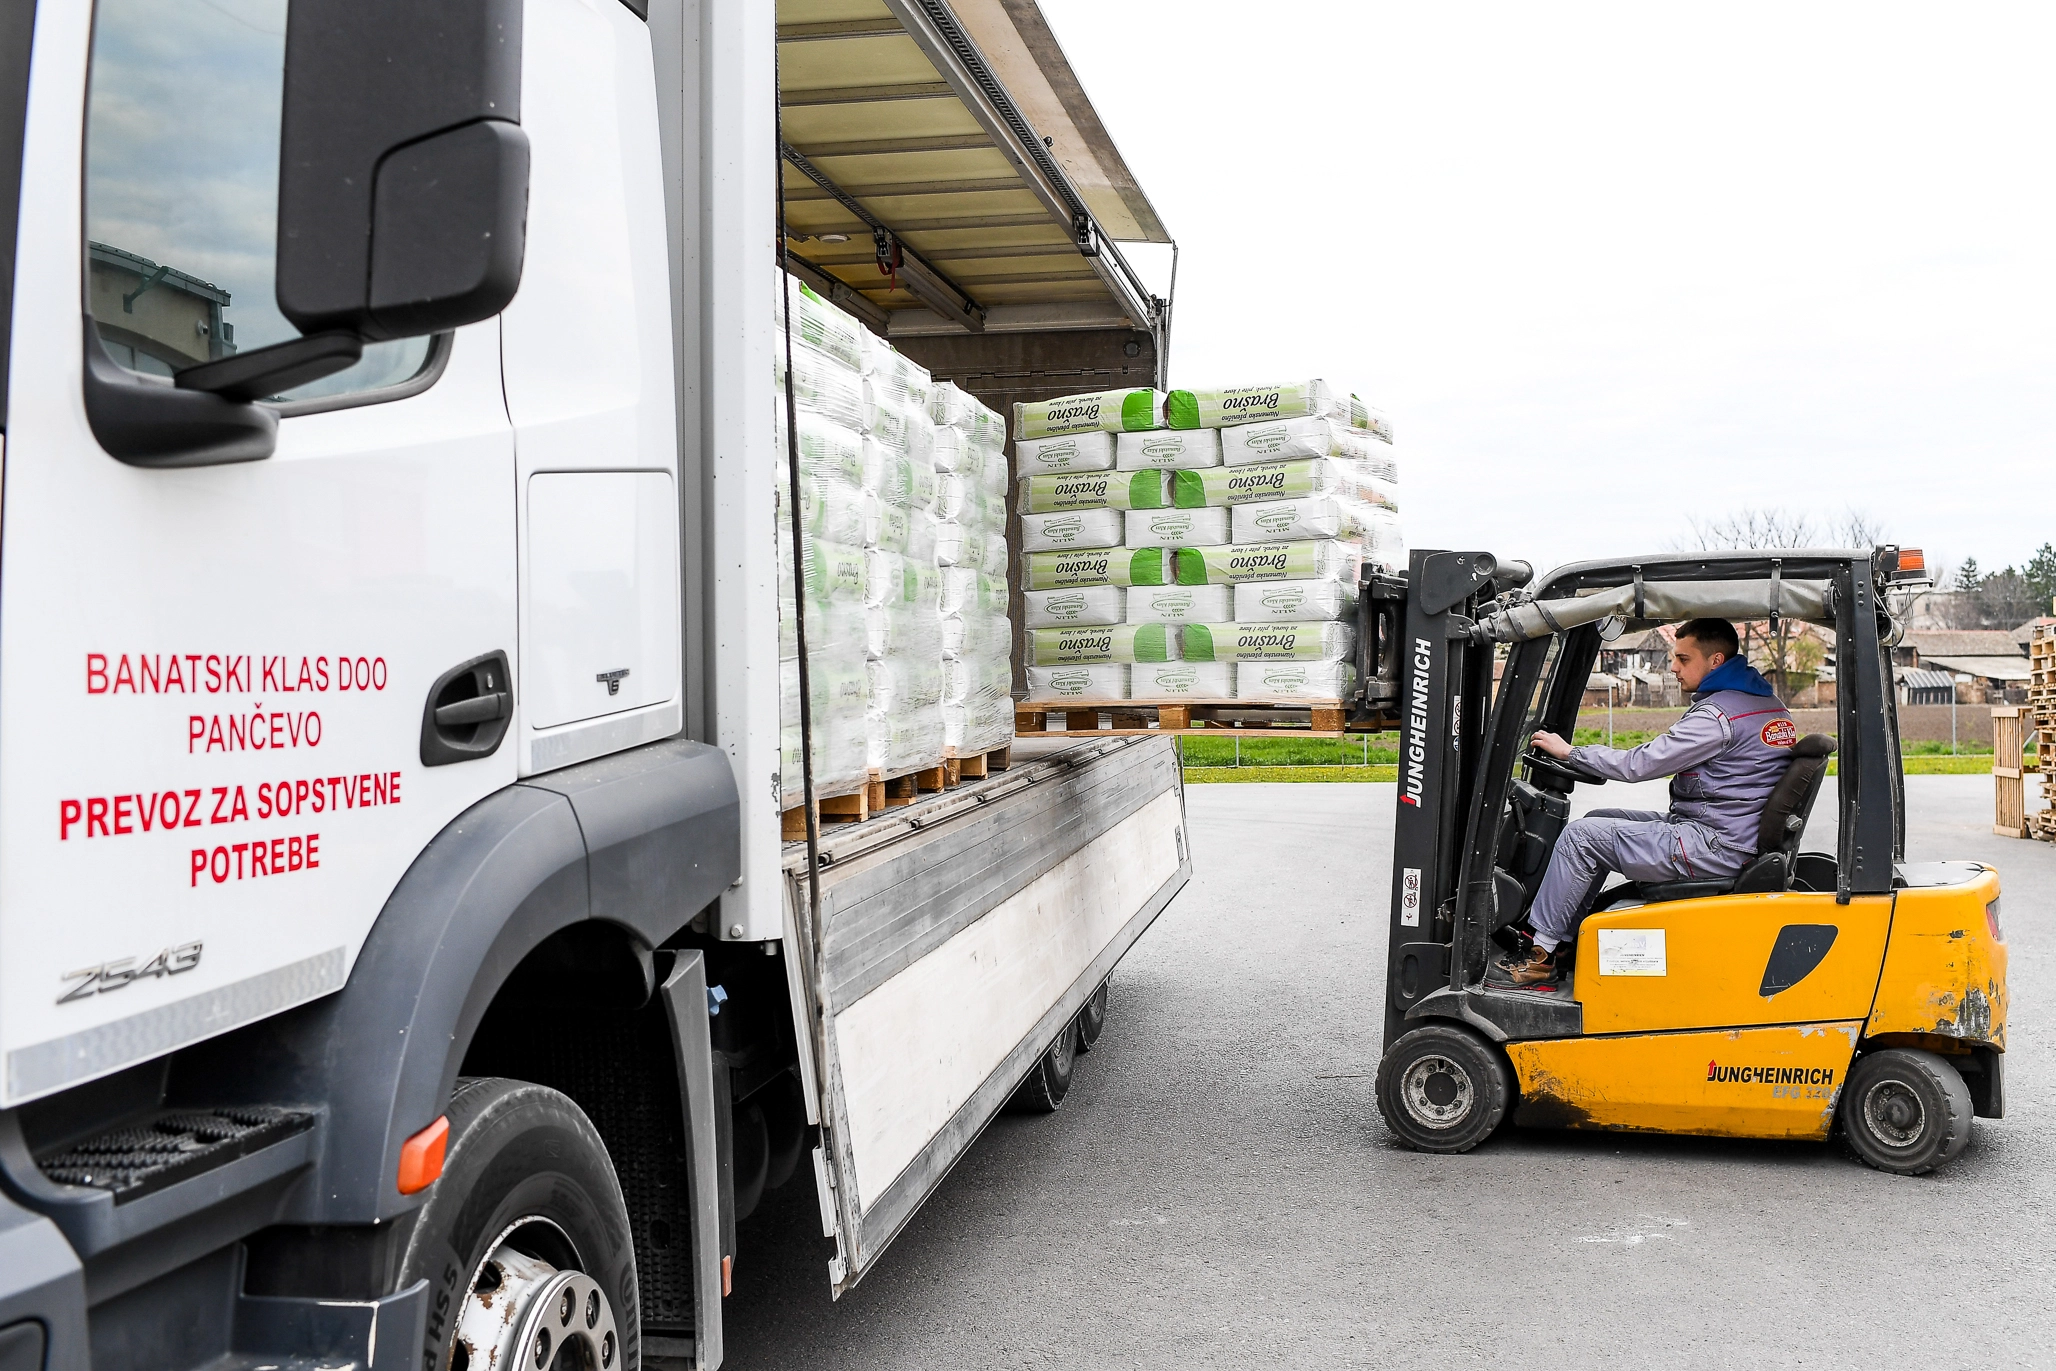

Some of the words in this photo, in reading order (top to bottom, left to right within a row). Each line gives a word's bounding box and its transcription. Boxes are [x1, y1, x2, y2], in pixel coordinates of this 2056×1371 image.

[1223, 393, 1279, 412] Brašno
[1048, 404, 1099, 423] Brašno
[1055, 481, 1107, 498] Brašno
[1229, 473, 1284, 492] Brašno
[1056, 559, 1107, 577] Brašno
[1230, 554, 1287, 572] Brašno
[1059, 637, 1111, 654] Brašno
[1238, 634, 1295, 651] Brašno
[87, 653, 251, 694] BANATSKI
[263, 655, 329, 692] KLAS
[339, 656, 387, 691] DOO
[189, 702, 322, 754] PANČEVO
[1406, 638, 1431, 808] JUNGHEINRICH
[60, 789, 202, 841] PREVOZ
[210, 785, 250, 825] ZA
[257, 771, 401, 819] SOPSTVENE
[191, 833, 320, 888] POTREBE
[56, 939, 203, 1006] 2543
[1706, 1064, 1834, 1085] JUNGHEINRICH
[1772, 1086, 1801, 1099] EFG
